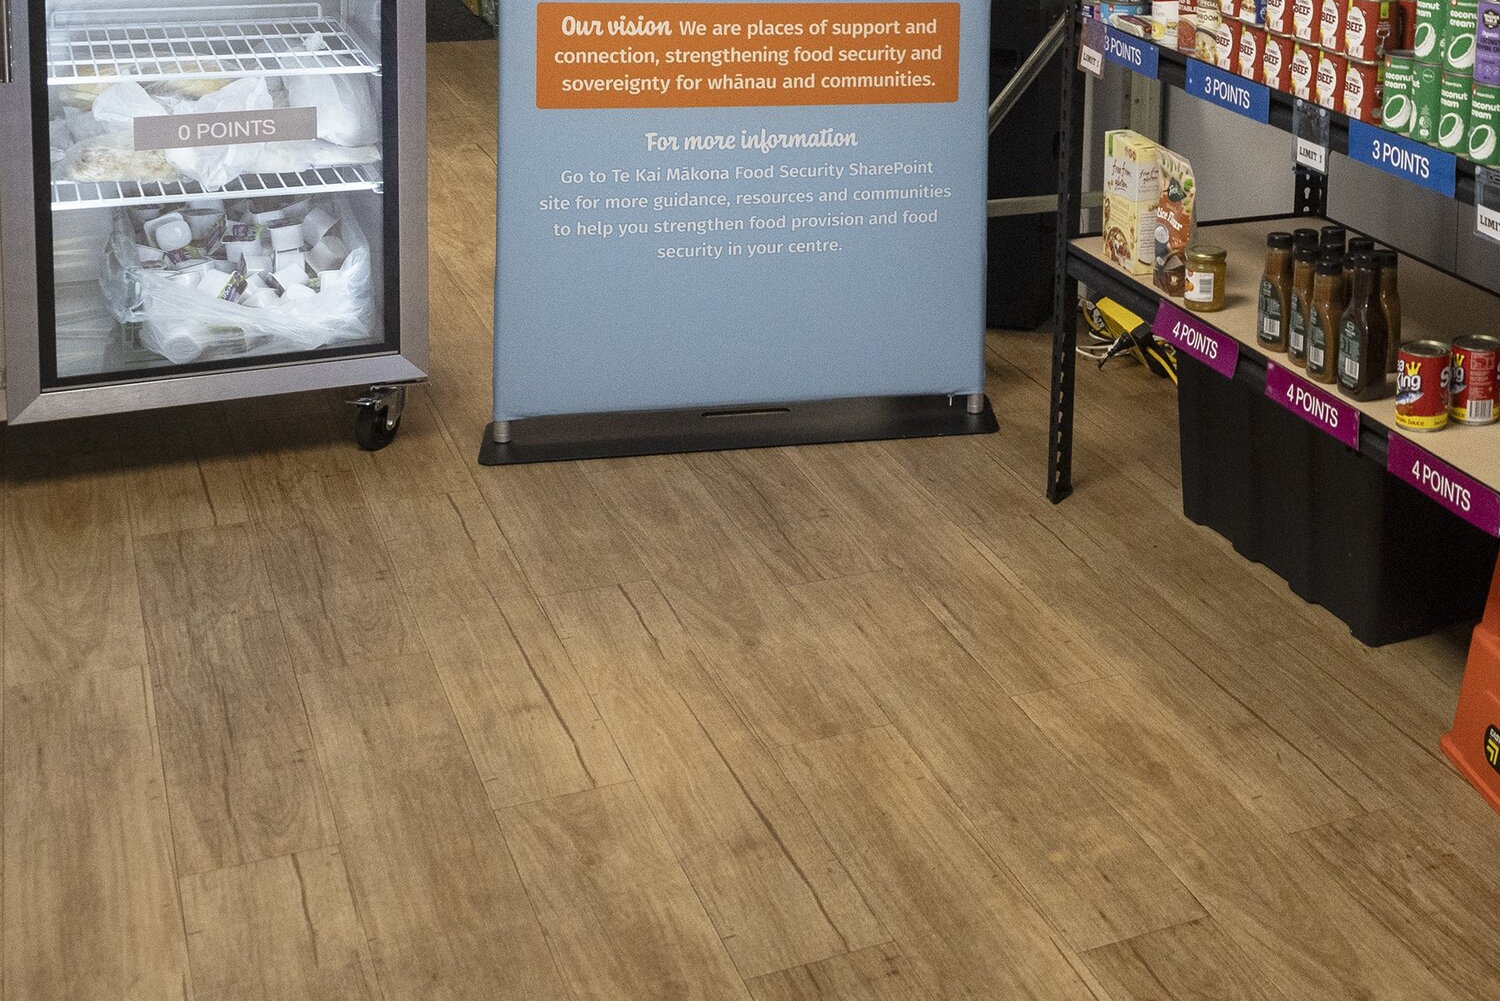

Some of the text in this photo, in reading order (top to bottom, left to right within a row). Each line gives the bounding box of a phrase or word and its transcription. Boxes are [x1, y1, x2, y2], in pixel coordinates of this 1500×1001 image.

[1294, 4, 1310, 15] BEEF
[562, 15, 937, 39] Our vision We are places of support and
[1347, 21, 1362, 33] BEEF
[554, 45, 942, 67] connection, strengthening food security and
[1083, 52, 1096, 66] LIMIT
[1104, 35, 1142, 66] 3 POINTS
[562, 71, 935, 94] sovereignty for whānau and communities.
[1205, 77, 1250, 109] 3 POINTS
[178, 119, 276, 140] 0 POINTS
[645, 128, 858, 153] For more information
[1300, 145, 1318, 162] LIMIT
[1372, 140, 1430, 178] 3 POINTS
[561, 160, 933, 184] Go to Te Kai Mākona Food Security SharePoint
[539, 185, 952, 210] site for more guidance, resources and communities
[554, 210, 938, 238] to help you strengthen food provision and food
[657, 240, 842, 259] security in your centre.
[1172, 321, 1219, 359] 4 POINTS
[1286, 382, 1339, 428] 4 POINTS
[1412, 460, 1471, 512] 4 POINTS
